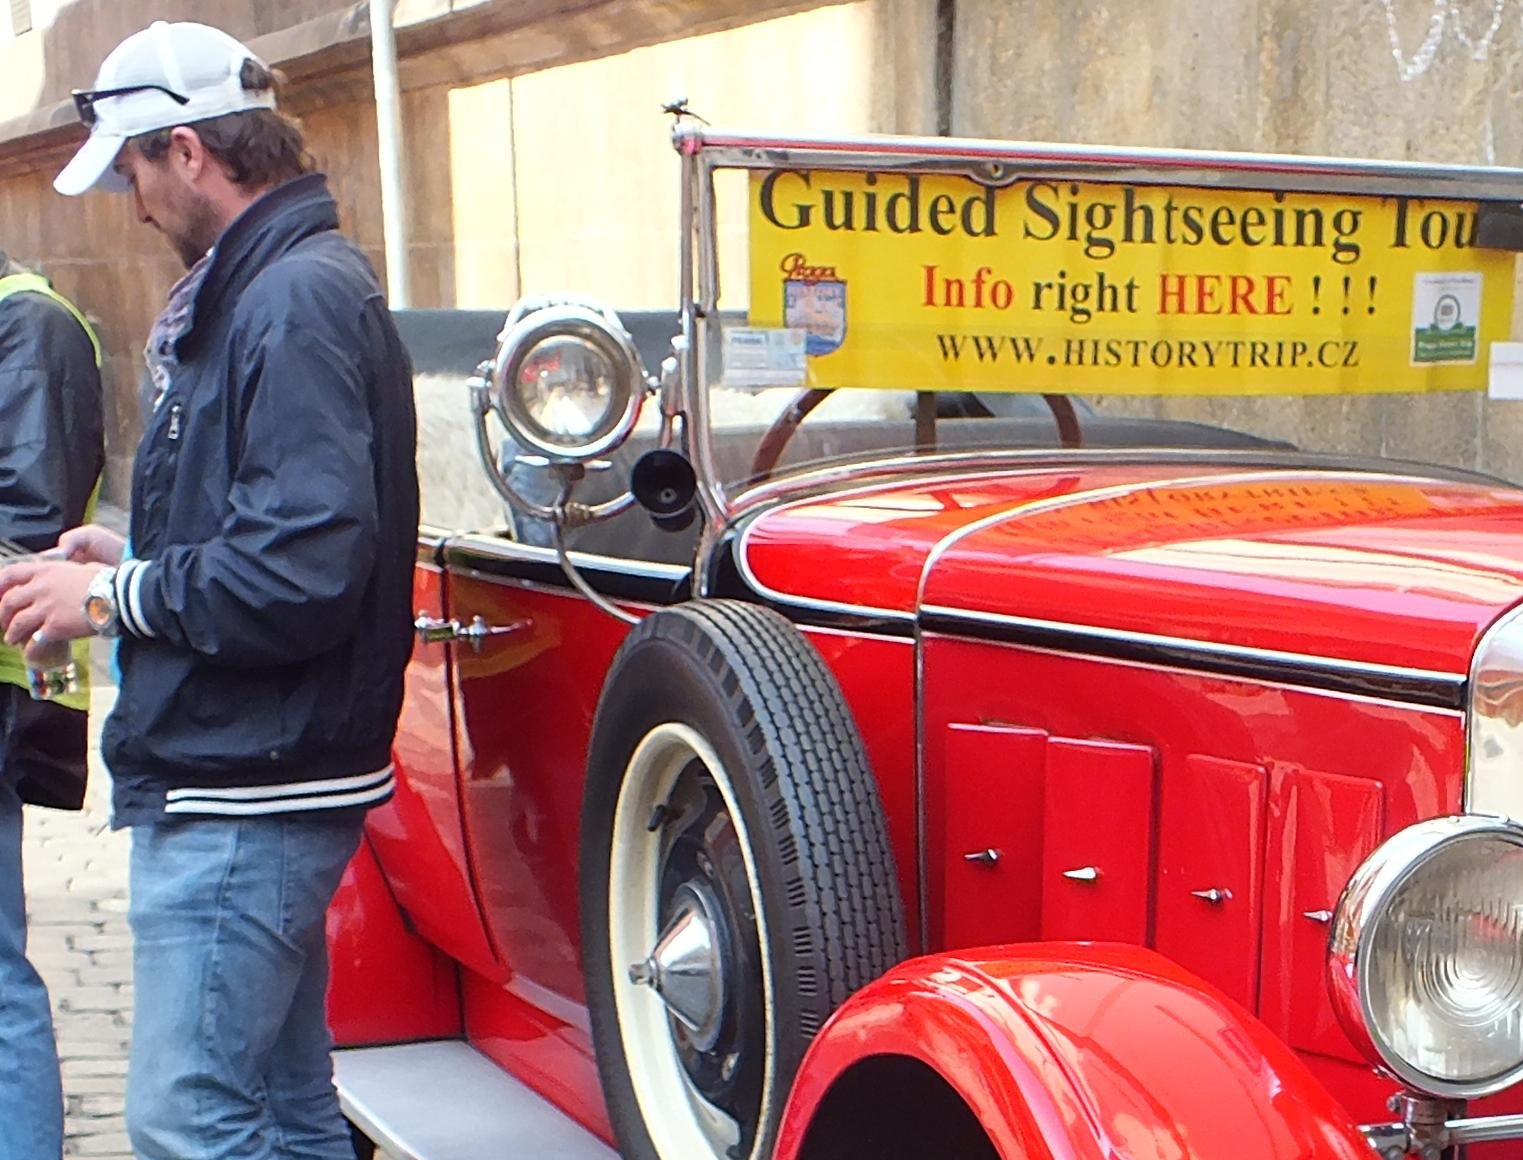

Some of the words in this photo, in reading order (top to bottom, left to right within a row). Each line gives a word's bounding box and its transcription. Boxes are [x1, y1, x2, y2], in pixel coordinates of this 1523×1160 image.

[759, 168, 997, 237] Guided
[1024, 182, 1363, 265] Sightseeing
[1386, 197, 1479, 249] Tou
[922, 264, 1014, 311] Info
[1031, 269, 1139, 325] right
[1156, 273, 1293, 316] HERE
[936, 333, 1360, 369] WWW.HISTORYTRIP.CZ
